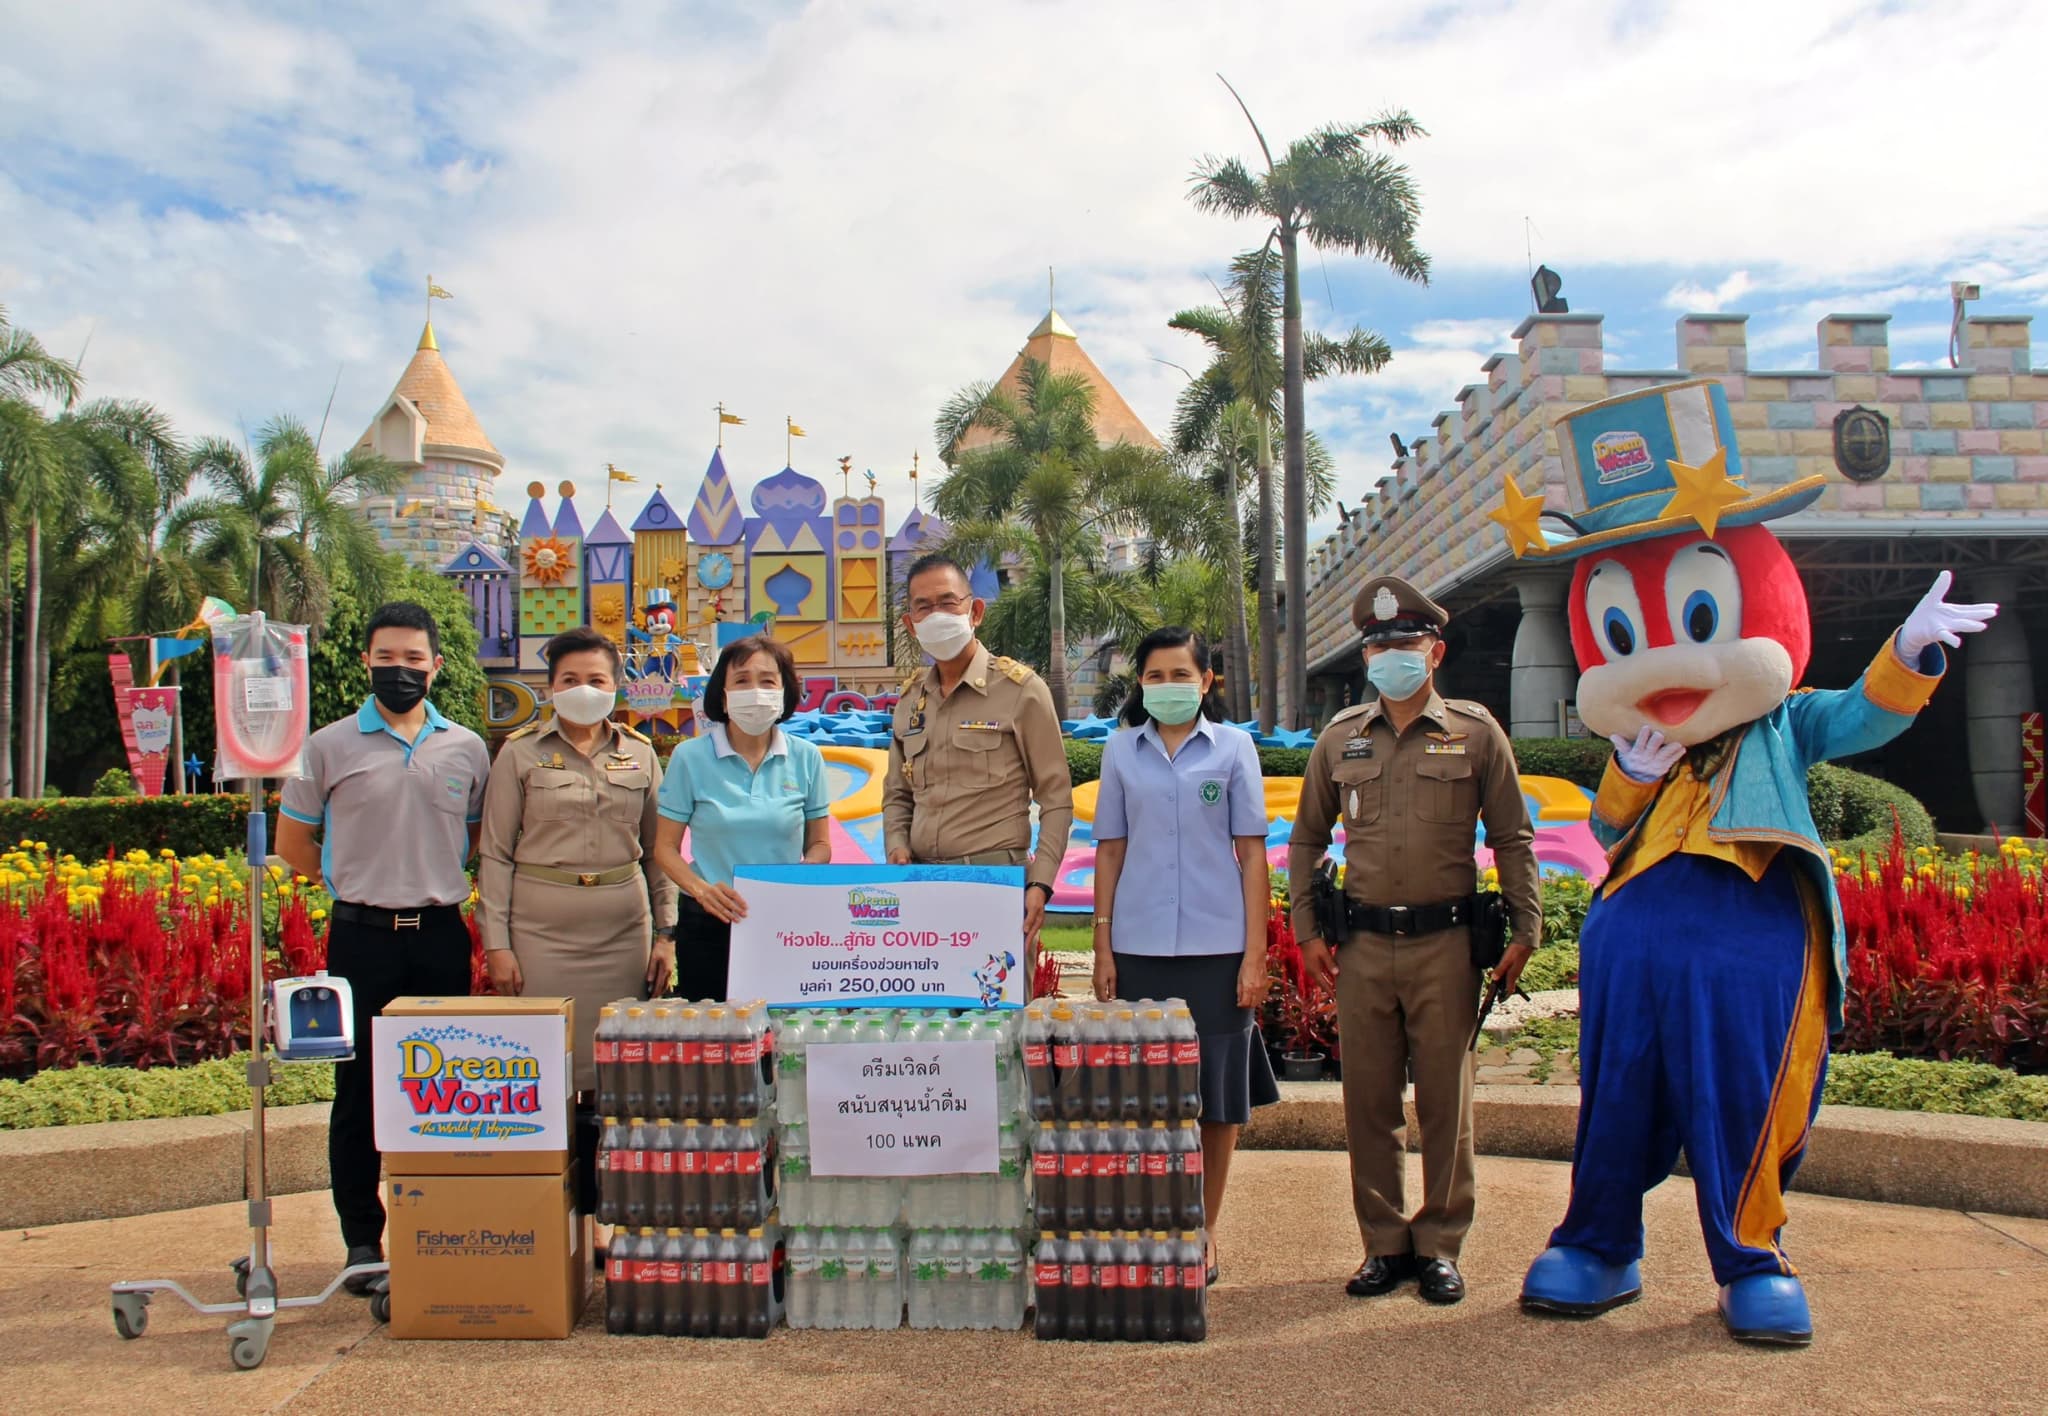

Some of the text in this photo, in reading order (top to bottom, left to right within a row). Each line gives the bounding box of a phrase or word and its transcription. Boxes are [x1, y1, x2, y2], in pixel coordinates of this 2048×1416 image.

[1594, 436, 1644, 459] Dream
[1597, 447, 1648, 474] World
[848, 890, 900, 906] Dream
[848, 904, 900, 918] World
[800, 978, 945, 996] มูลค่า 250,000 บาท
[398, 1039, 541, 1081] Dream
[862, 1055, 941, 1077] ดรีมเวิลด์
[400, 1079, 542, 1115] World
[837, 1087, 967, 1118] สนับสนุนน้ำดื่ม
[418, 1118, 537, 1141] The World of Happiness
[866, 1133, 941, 1149] 100 แพค
[416, 1248, 536, 1256] HEALTHCARE
